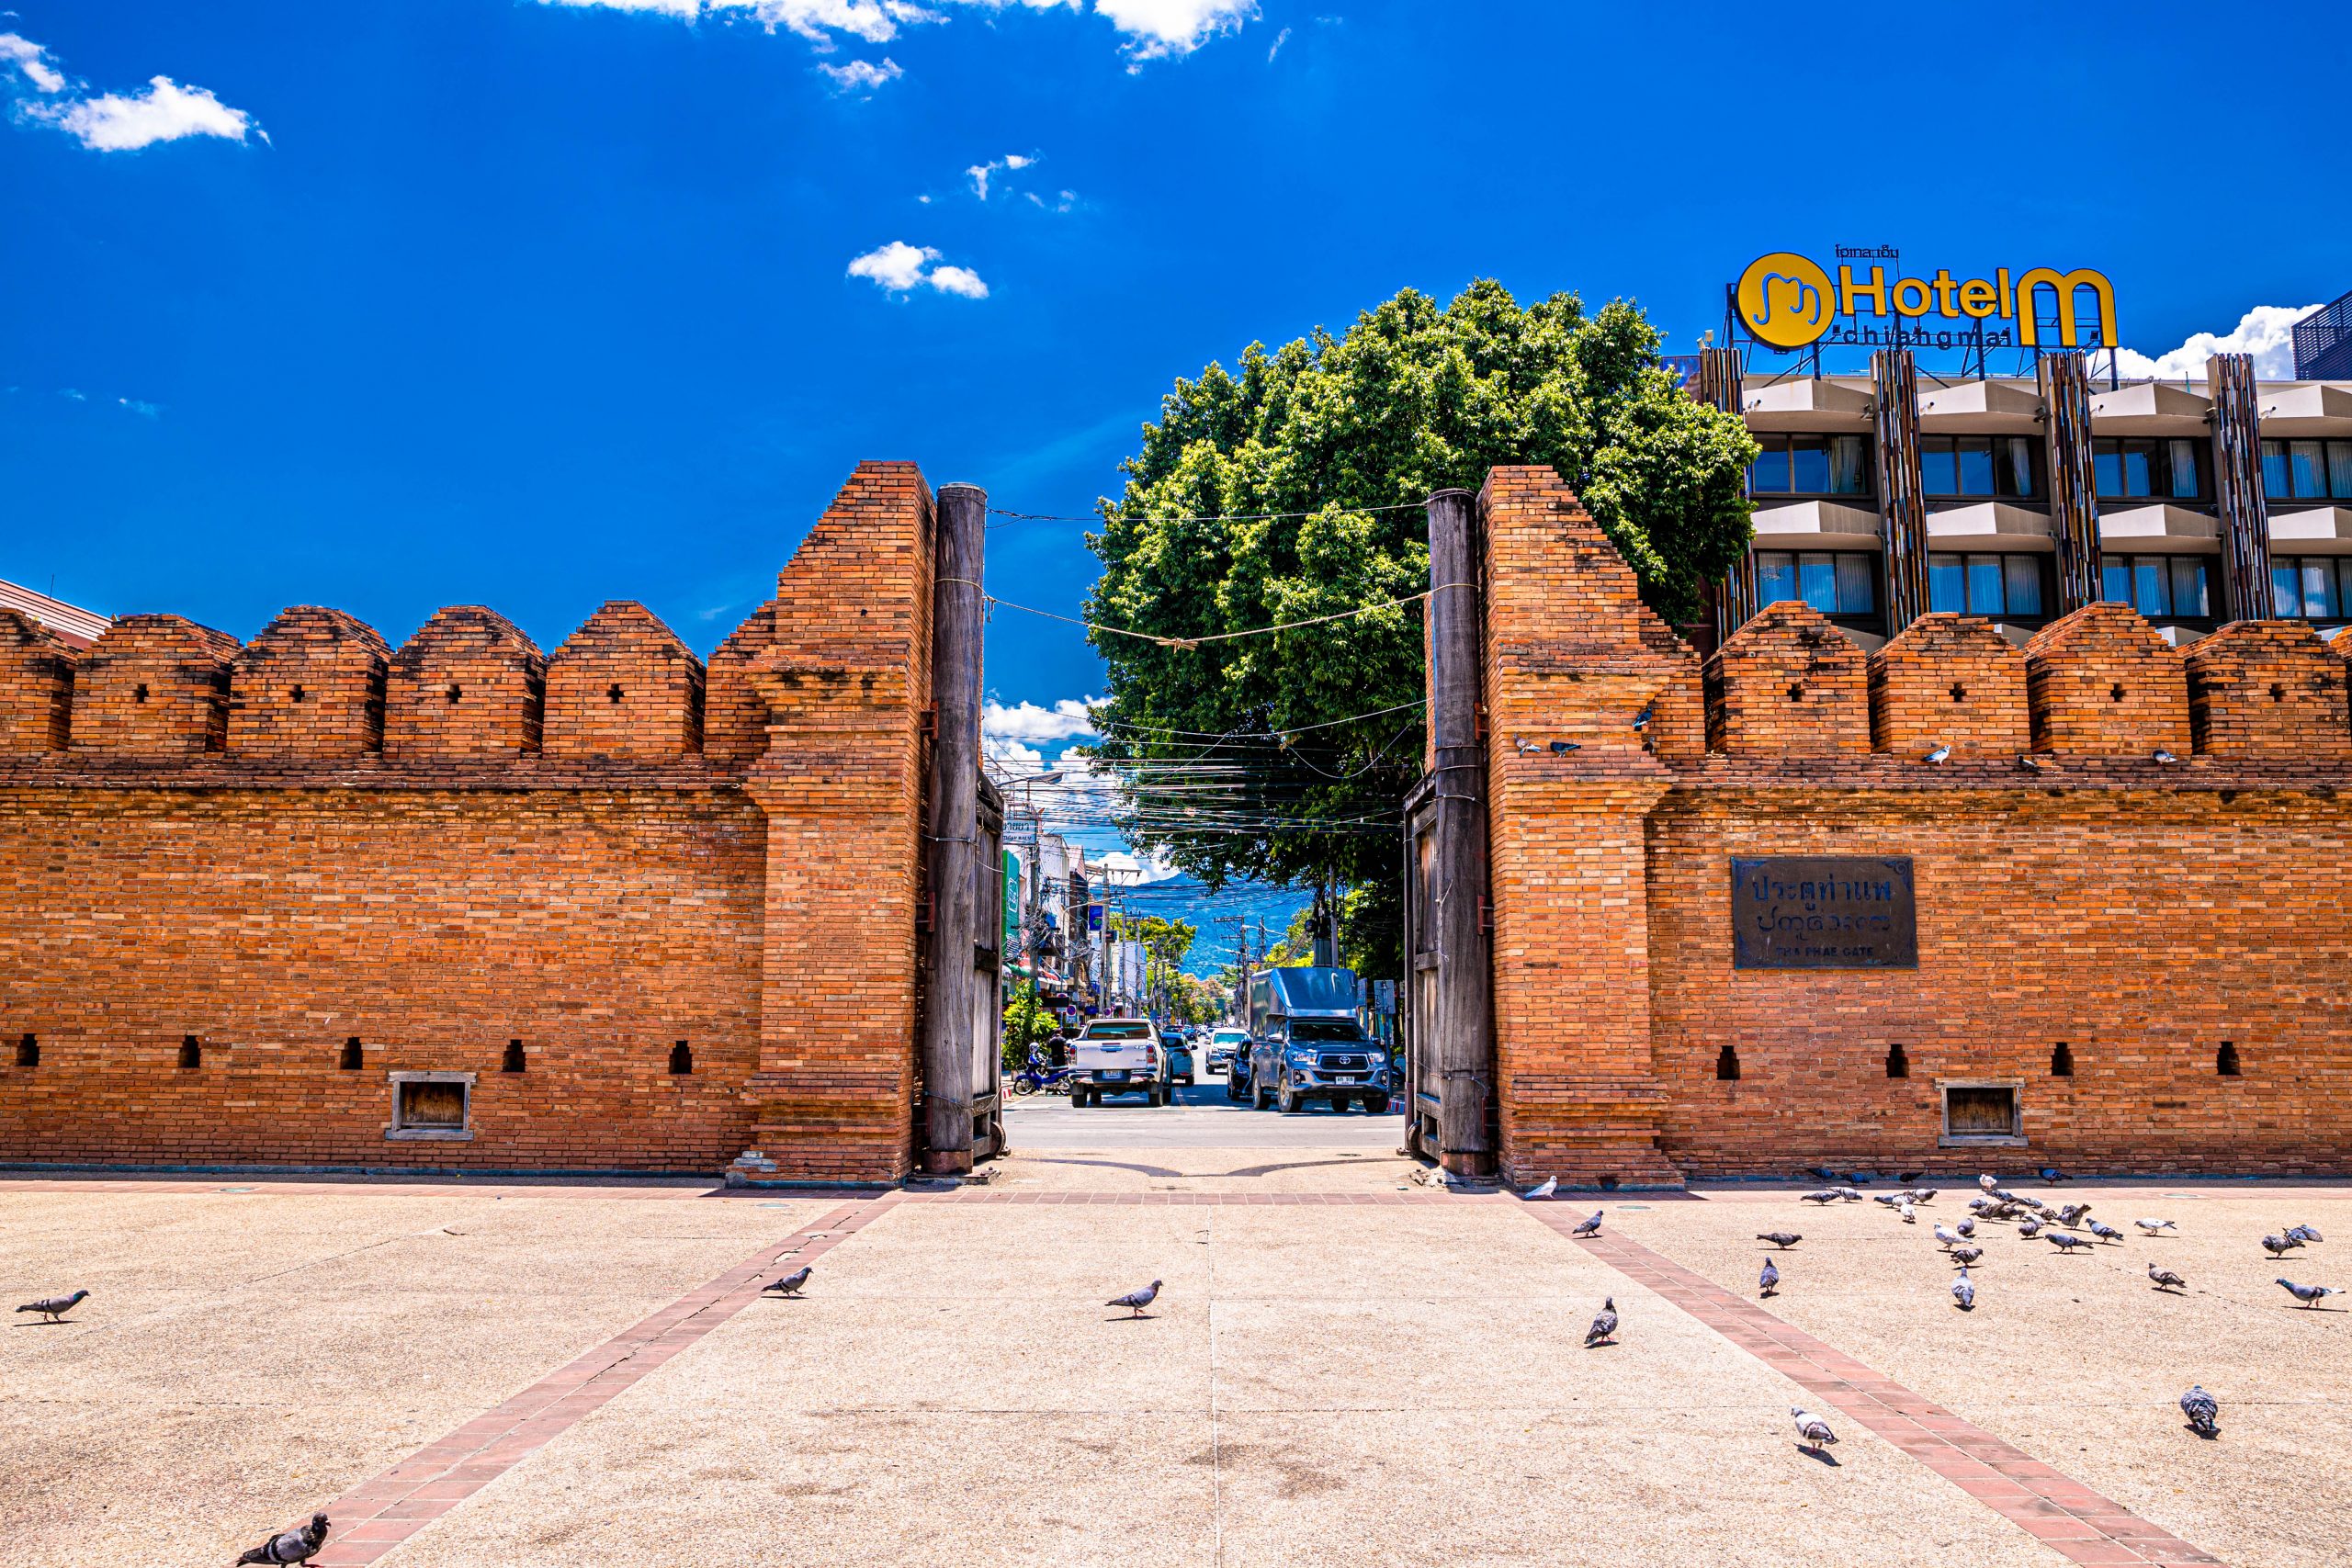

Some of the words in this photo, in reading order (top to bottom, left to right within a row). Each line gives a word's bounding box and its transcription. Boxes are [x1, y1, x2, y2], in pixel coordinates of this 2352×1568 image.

[1838, 265, 2013, 321] Hotel
[1752, 874, 1891, 911] ประตูท่าแพ
[1776, 947, 1801, 956] THA
[1805, 947, 1838, 956] PHAE
[1842, 947, 1874, 956] GATE
